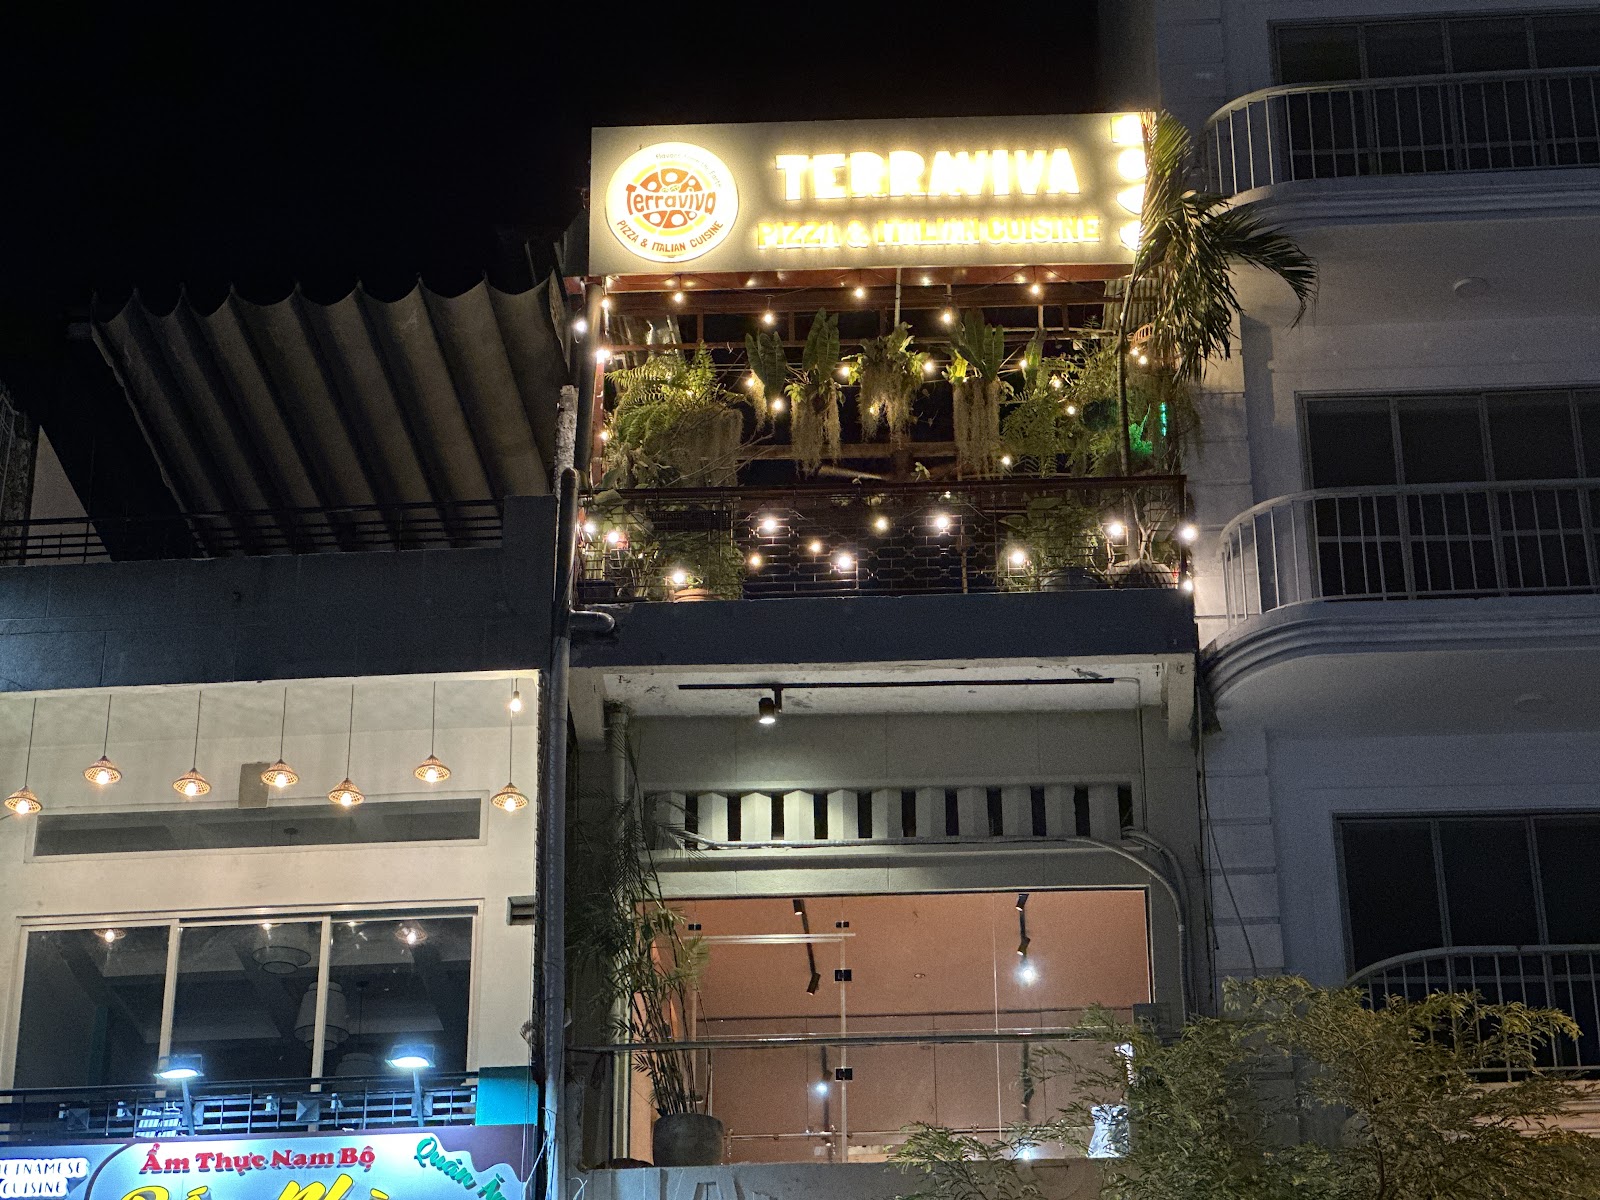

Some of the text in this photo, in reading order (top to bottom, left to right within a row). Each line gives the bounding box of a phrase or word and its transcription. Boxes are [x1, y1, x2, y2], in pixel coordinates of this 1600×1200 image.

[776, 148, 1080, 201] TERRAVIVA
[626, 184, 716, 215] Terraviva
[617, 220, 724, 253] PIZZA & ITALIAN CUISINE
[758, 215, 1101, 249] PIZZA & ITALIAN CUISINE
[195, 1152, 269, 1176] Thực
[270, 1149, 335, 1169] Nam
[337, 1145, 376, 1172] Bộ
[414, 1136, 477, 1190] Quán
[3, 1181, 61, 1194] CUISINE
